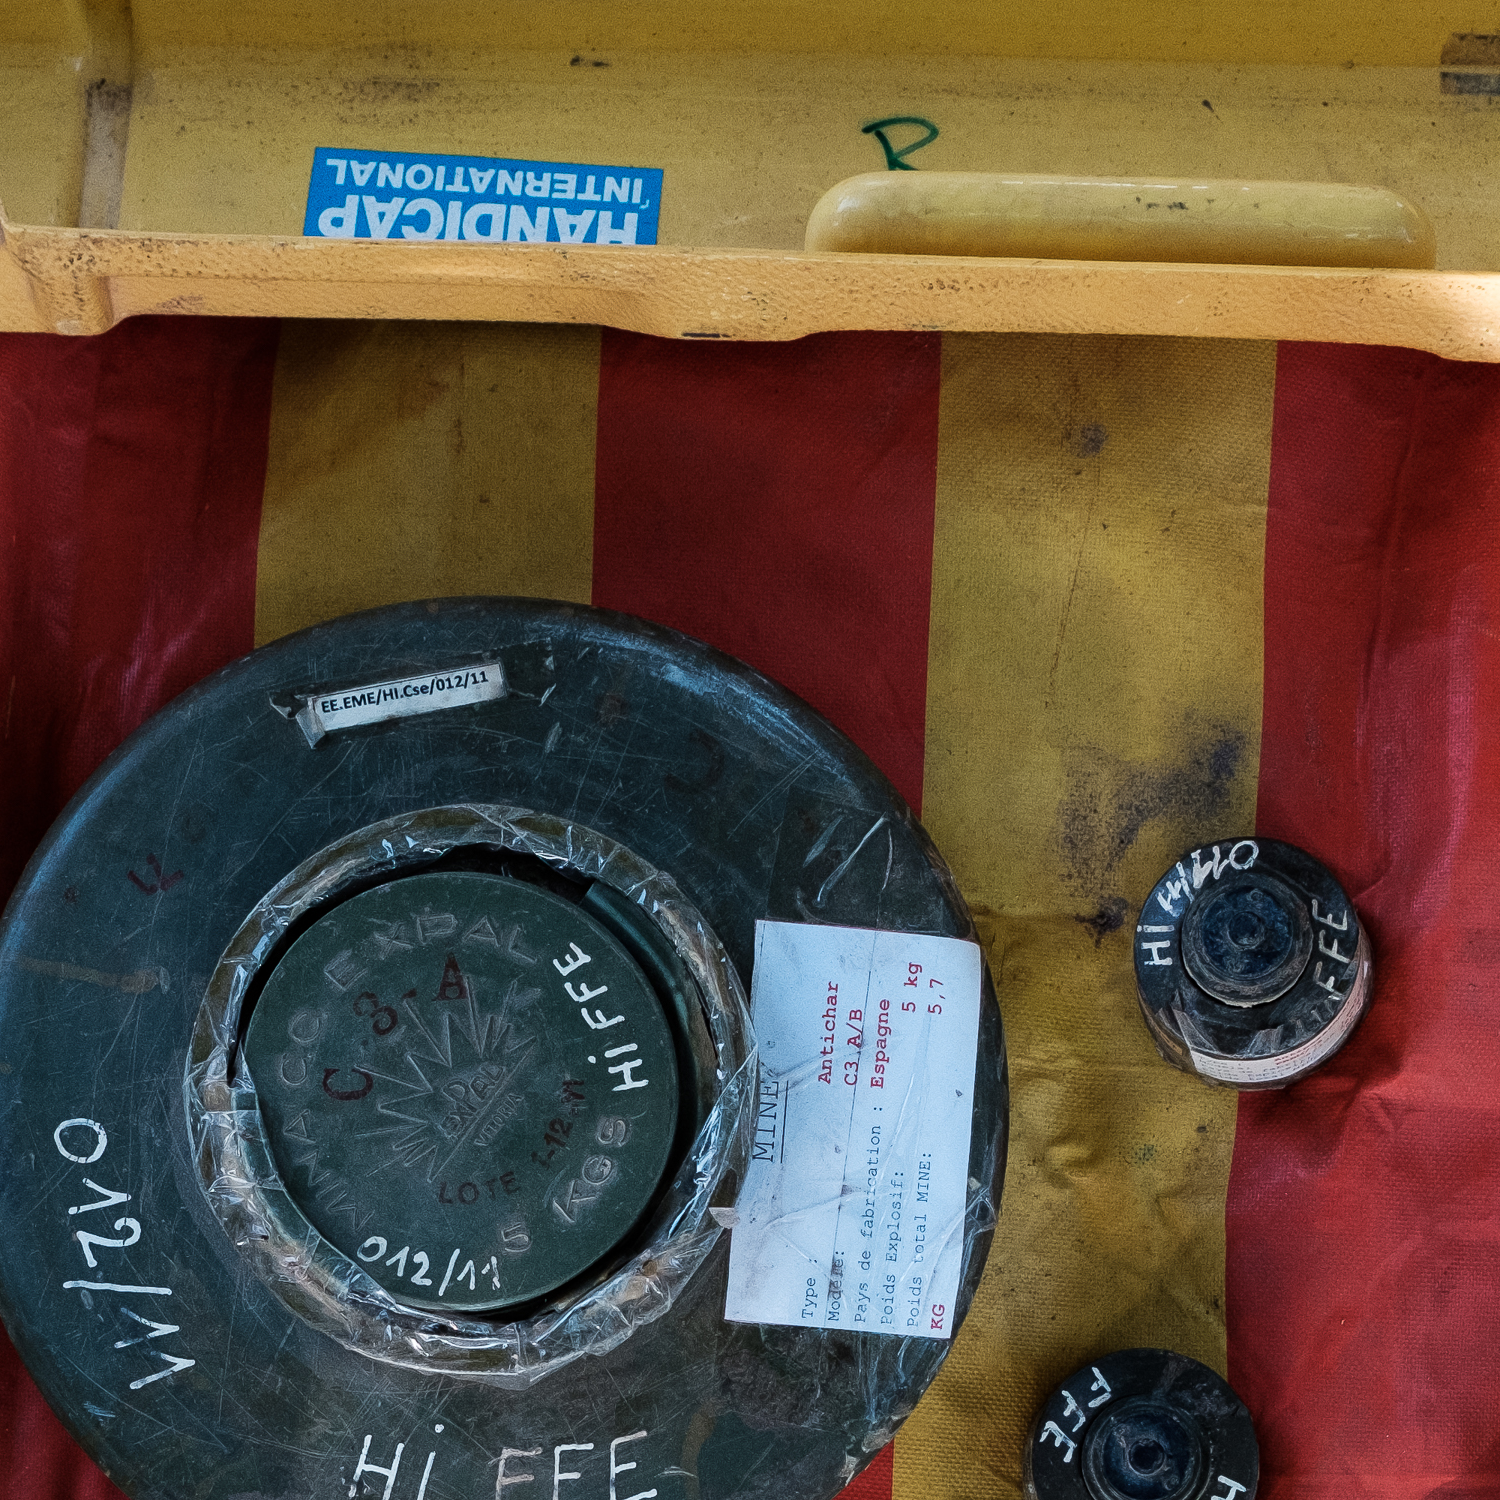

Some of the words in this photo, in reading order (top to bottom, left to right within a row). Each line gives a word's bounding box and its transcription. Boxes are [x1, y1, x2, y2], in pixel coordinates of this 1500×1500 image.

[325, 158, 644, 204] INTERNATIONAL
[318, 193, 638, 245] HANDICAP
[321, 670, 489, 713] EE.EME/HI.Cse/012/11
[904, 962, 924, 987] kg
[1311, 899, 1351, 1001] FFE
[552, 941, 626, 1030] FFE
[901, 1001, 915, 1013] 5
[928, 979, 946, 1015] 5,7
[846, 1008, 864, 1047] A/B
[870, 999, 893, 1090] Espagne
[843, 1060, 858, 1087] C3
[752, 1079, 780, 1163] MINE
[801, 1277, 816, 1320] Type
[817, 981, 841, 1085] Antichar
[859, 1125, 882, 1239] fabrication
[915, 1151, 933, 1204] MINE:
[884, 1170, 905, 1262] Explosif:
[911, 1214, 927, 1262] total
[857, 1249, 872, 1271] de
[853, 1280, 871, 1324] Pays
[879, 1273, 896, 1326] Poids
[906, 1275, 923, 1327] Poids
[929, 1303, 946, 1331] KG
[1039, 1367, 1112, 1463] FFE
